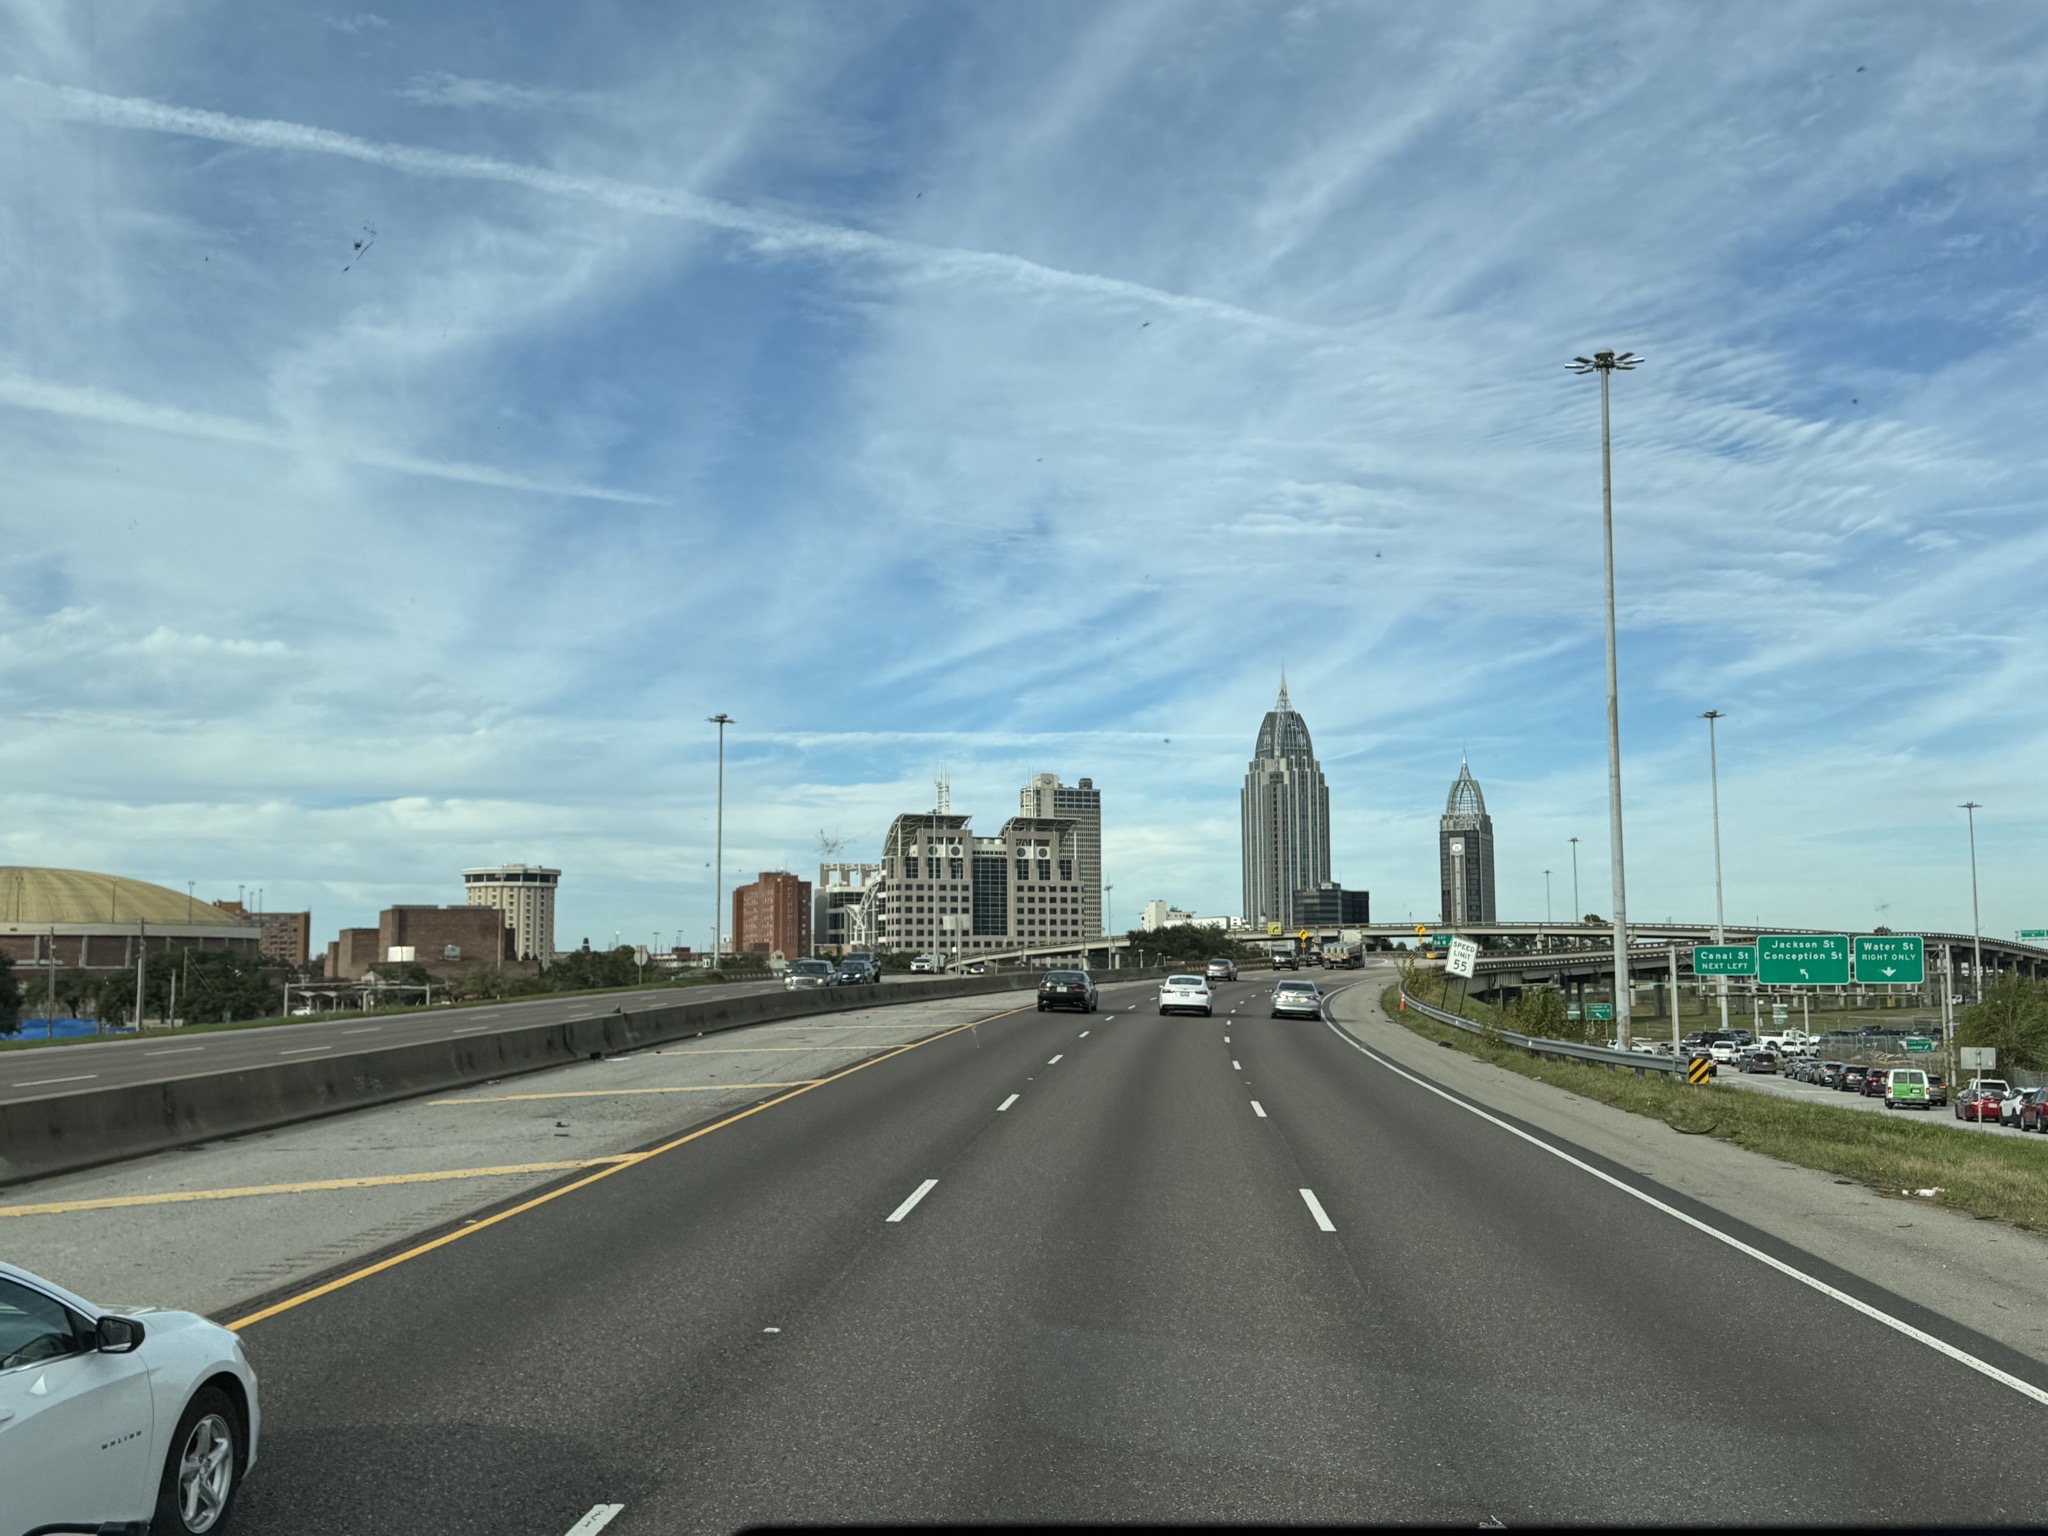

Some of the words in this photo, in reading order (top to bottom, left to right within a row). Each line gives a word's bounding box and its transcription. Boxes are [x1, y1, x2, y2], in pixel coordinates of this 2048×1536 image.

[1453, 941, 1475, 952] SPEED
[1771, 940, 1817, 949] Jackson
[1823, 940, 1835, 948] St
[1863, 942, 1896, 951] Water
[1902, 942, 1914, 950] St
[1453, 950, 1471, 960] LIMIT
[1700, 951, 1732, 960] Canal
[1737, 951, 1749, 960] St
[1763, 952, 1826, 961] Conception
[1831, 952, 1842, 960] St
[1453, 959, 1467, 971] 55
